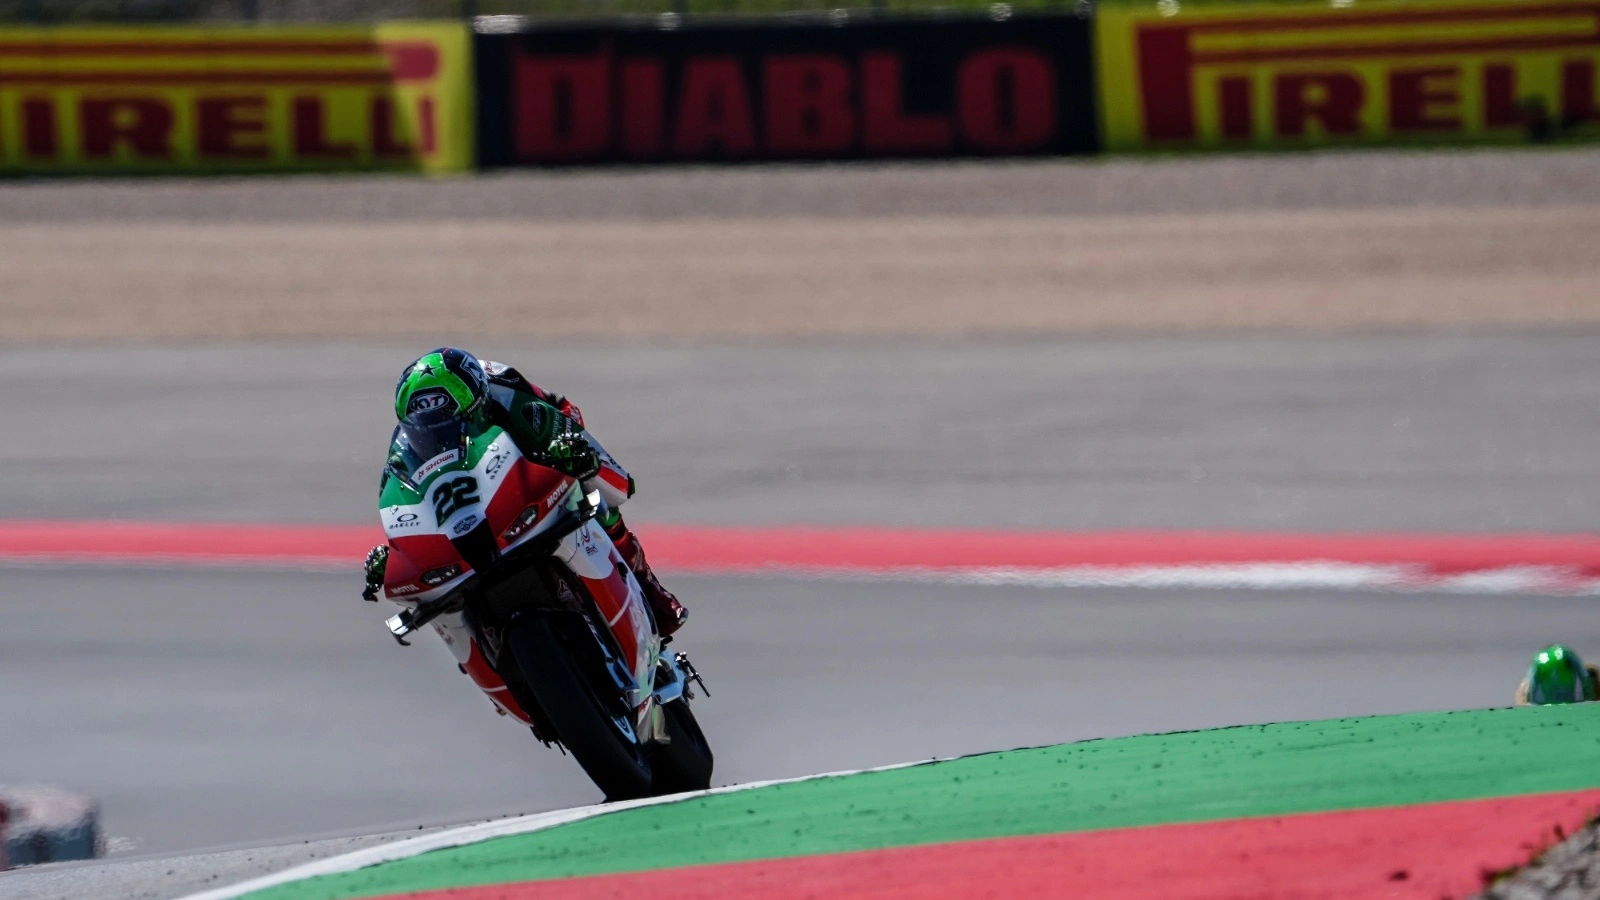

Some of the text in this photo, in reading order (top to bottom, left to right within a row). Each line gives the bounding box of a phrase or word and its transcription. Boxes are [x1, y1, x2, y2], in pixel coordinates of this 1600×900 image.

[1133, 8, 1600, 142] PIRELL
[511, 46, 1058, 158] DIABLO
[425, 453, 454, 473] SHOWA
[490, 450, 511, 480] OAKLEY
[432, 476, 480, 528] 22
[547, 480, 569, 508] MOTUL
[388, 521, 422, 530] OAKLEY
[391, 583, 420, 595] MOTUL
